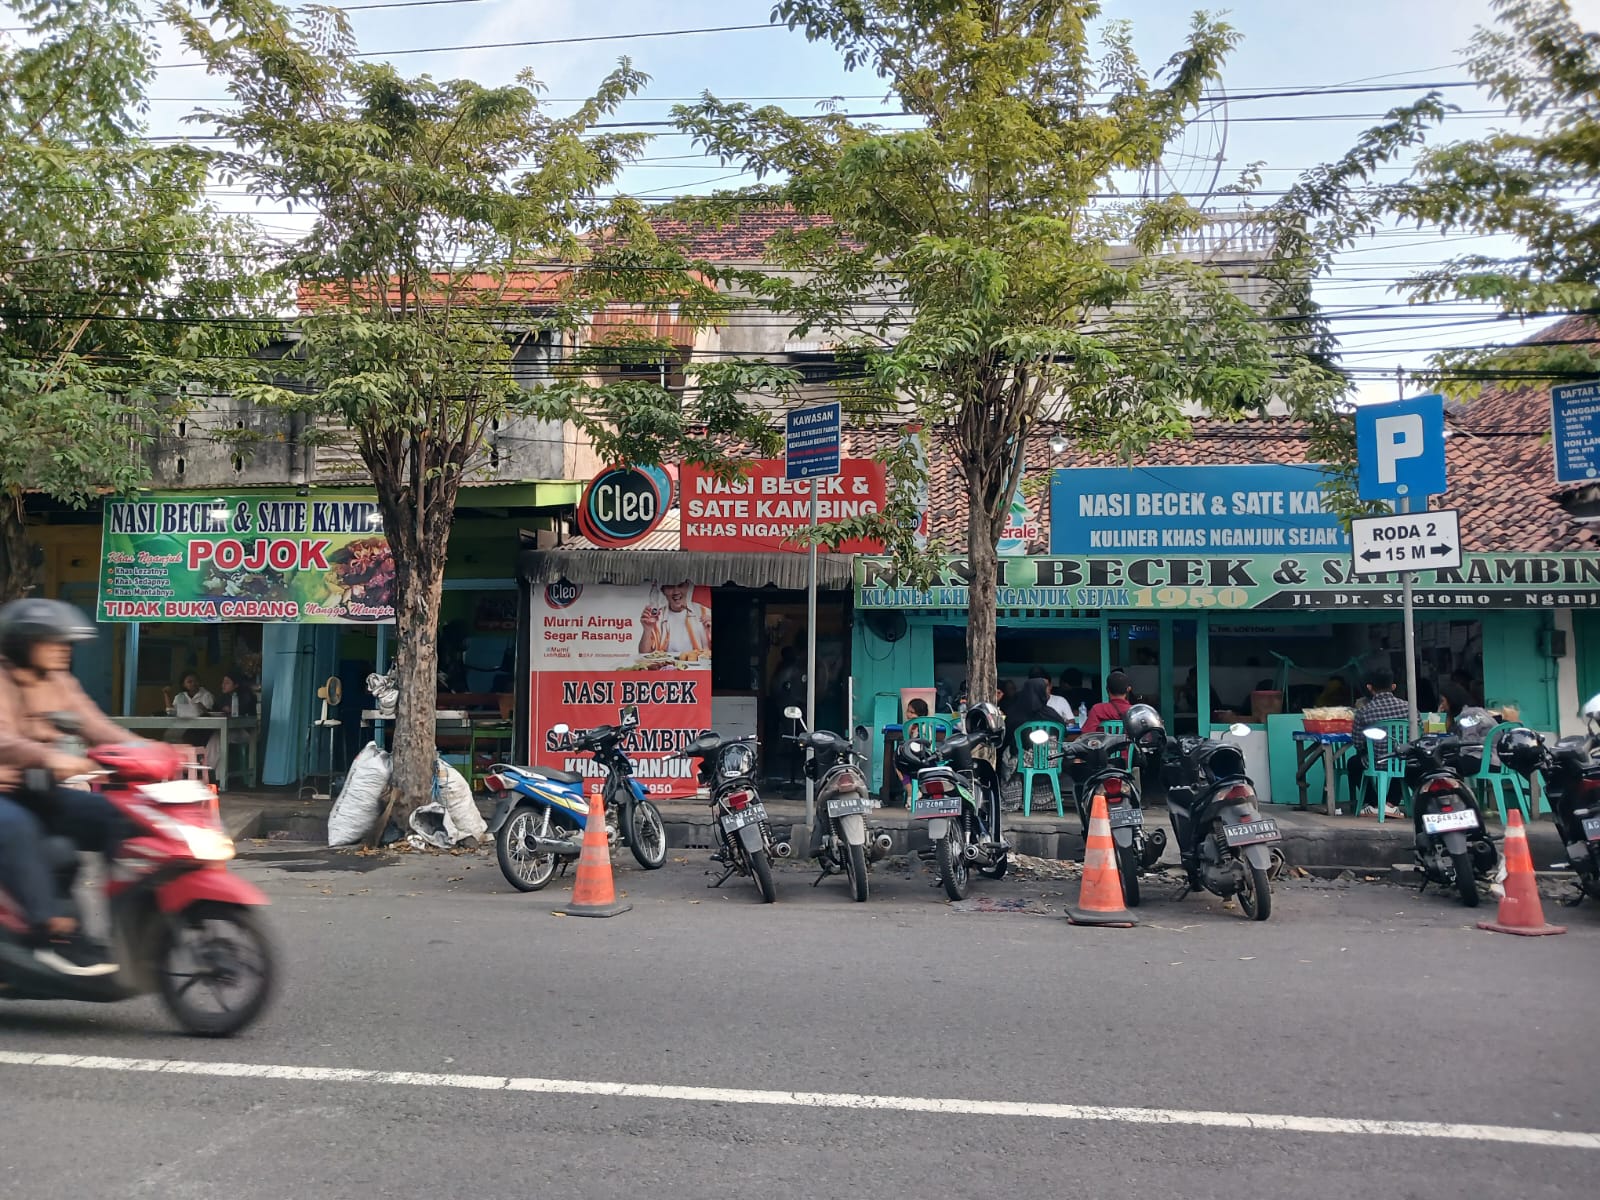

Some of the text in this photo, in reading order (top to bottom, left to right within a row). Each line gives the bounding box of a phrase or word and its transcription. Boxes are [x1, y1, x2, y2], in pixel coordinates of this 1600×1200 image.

[1560, 387, 1594, 399] DAFTAR
[793, 411, 834, 427] KAWASAN
[1375, 413, 1424, 484] P
[1563, 439, 1582, 448] NON
[695, 476, 869, 495] NASI BECEK &
[598, 484, 654, 521] Cleo
[687, 500, 878, 518] SATE KAMBING
[1079, 494, 1131, 517] NASI
[1136, 492, 1206, 516] BECEK
[1211, 494, 1228, 516] &
[1232, 491, 1284, 515] SATE
[110, 503, 157, 534] NASI
[160, 503, 228, 534] BECEK
[233, 502, 253, 534] &
[257, 501, 308, 534] SATE
[686, 523, 737, 537] KHAS
[1090, 529, 1158, 548] KULINER
[1162, 529, 1205, 547] KHAS
[1210, 528, 1286, 546] NGANJUK
[1289, 527, 1338, 546] SEJAK
[1373, 523, 1437, 541] RODA 2
[107, 550, 184, 568] Khas Nganjuk
[187, 538, 332, 571] POJOK
[1385, 545, 1426, 561] 15 M
[114, 567, 169, 577] Khas Lezatnya
[1033, 558, 1258, 587] BECEK
[1273, 559, 1308, 585] &
[114, 578, 170, 588] Khas Sedapnya
[552, 584, 576, 598] Cleo
[114, 589, 132, 597] Khas
[861, 589, 933, 605] KULINER
[1077, 588, 1130, 606] SEJAK
[1133, 587, 1249, 607] 1950
[1293, 594, 1321, 606] Jl.
[1334, 594, 1370, 604] Dr.
[1383, 593, 1490, 605] Soetomo
[104, 601, 299, 618] TIDAK BUKA CABANG
[304, 602, 395, 618] Monggo Mampir
[544, 616, 633, 629] Murni Airnya
[544, 631, 633, 642] Segar Rasanya
[563, 681, 697, 704] NASI BECEK
[619, 729, 712, 752] AMBIN
[564, 758, 692, 778] KHAS GANJUK
